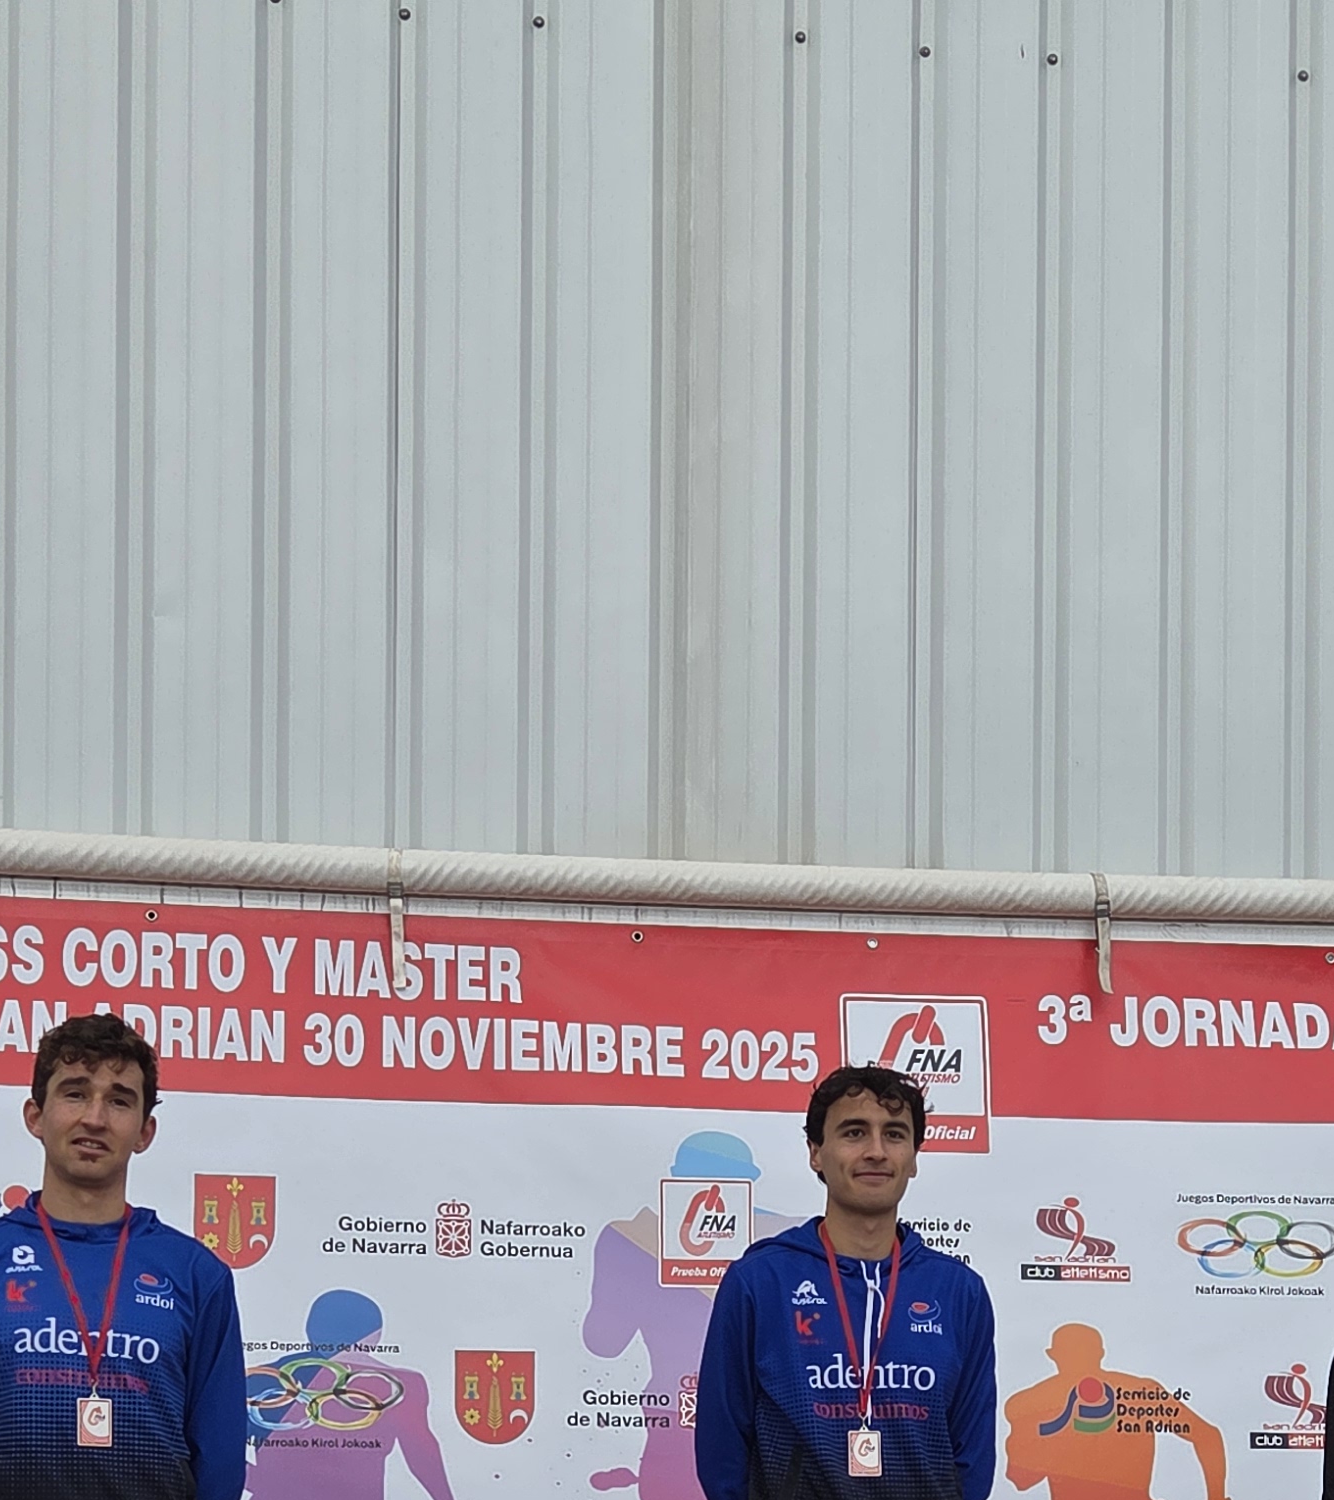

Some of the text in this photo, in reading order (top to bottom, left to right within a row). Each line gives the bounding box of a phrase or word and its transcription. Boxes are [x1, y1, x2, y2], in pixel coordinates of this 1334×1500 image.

[62, 926, 245, 993] CORTO
[262, 936, 298, 994] Y
[314, 937, 523, 1004] MASTER
[303, 1012, 366, 1068] 30
[382, 1016, 686, 1079] NOVIEMBRE
[701, 1028, 819, 1083] 2025
[905, 1048, 962, 1073] FNA
[923, 1125, 976, 1141] Oficial
[1176, 1193, 1214, 1205] Juegos
[1217, 1193, 1276, 1205] Deportivos
[1278, 1194, 1291, 1205] de
[338, 1216, 427, 1234] Gobierno
[480, 1219, 586, 1238] Nafarroako
[699, 1214, 736, 1232] FNA
[953, 1217, 972, 1232] de
[322, 1238, 427, 1256] de Navarra
[480, 1241, 574, 1259] Gobernua
[1026, 1265, 1055, 1279] club
[1195, 1284, 1325, 1296] Nafarroako Kirol Jokoak
[135, 1292, 175, 1311] ardoi
[13, 1316, 161, 1365] adentro
[354, 1342, 401, 1354] Navarra
[582, 1389, 670, 1406] Gobierno
[1173, 1387, 1192, 1402] de
[567, 1411, 670, 1428] de Navarra
[1116, 1403, 1180, 1420] Deportes
[1116, 1420, 1190, 1434] San Adrian
[311, 1437, 339, 1449] Kirol
[341, 1438, 382, 1450] Jokoak
[1254, 1434, 1283, 1446] club
